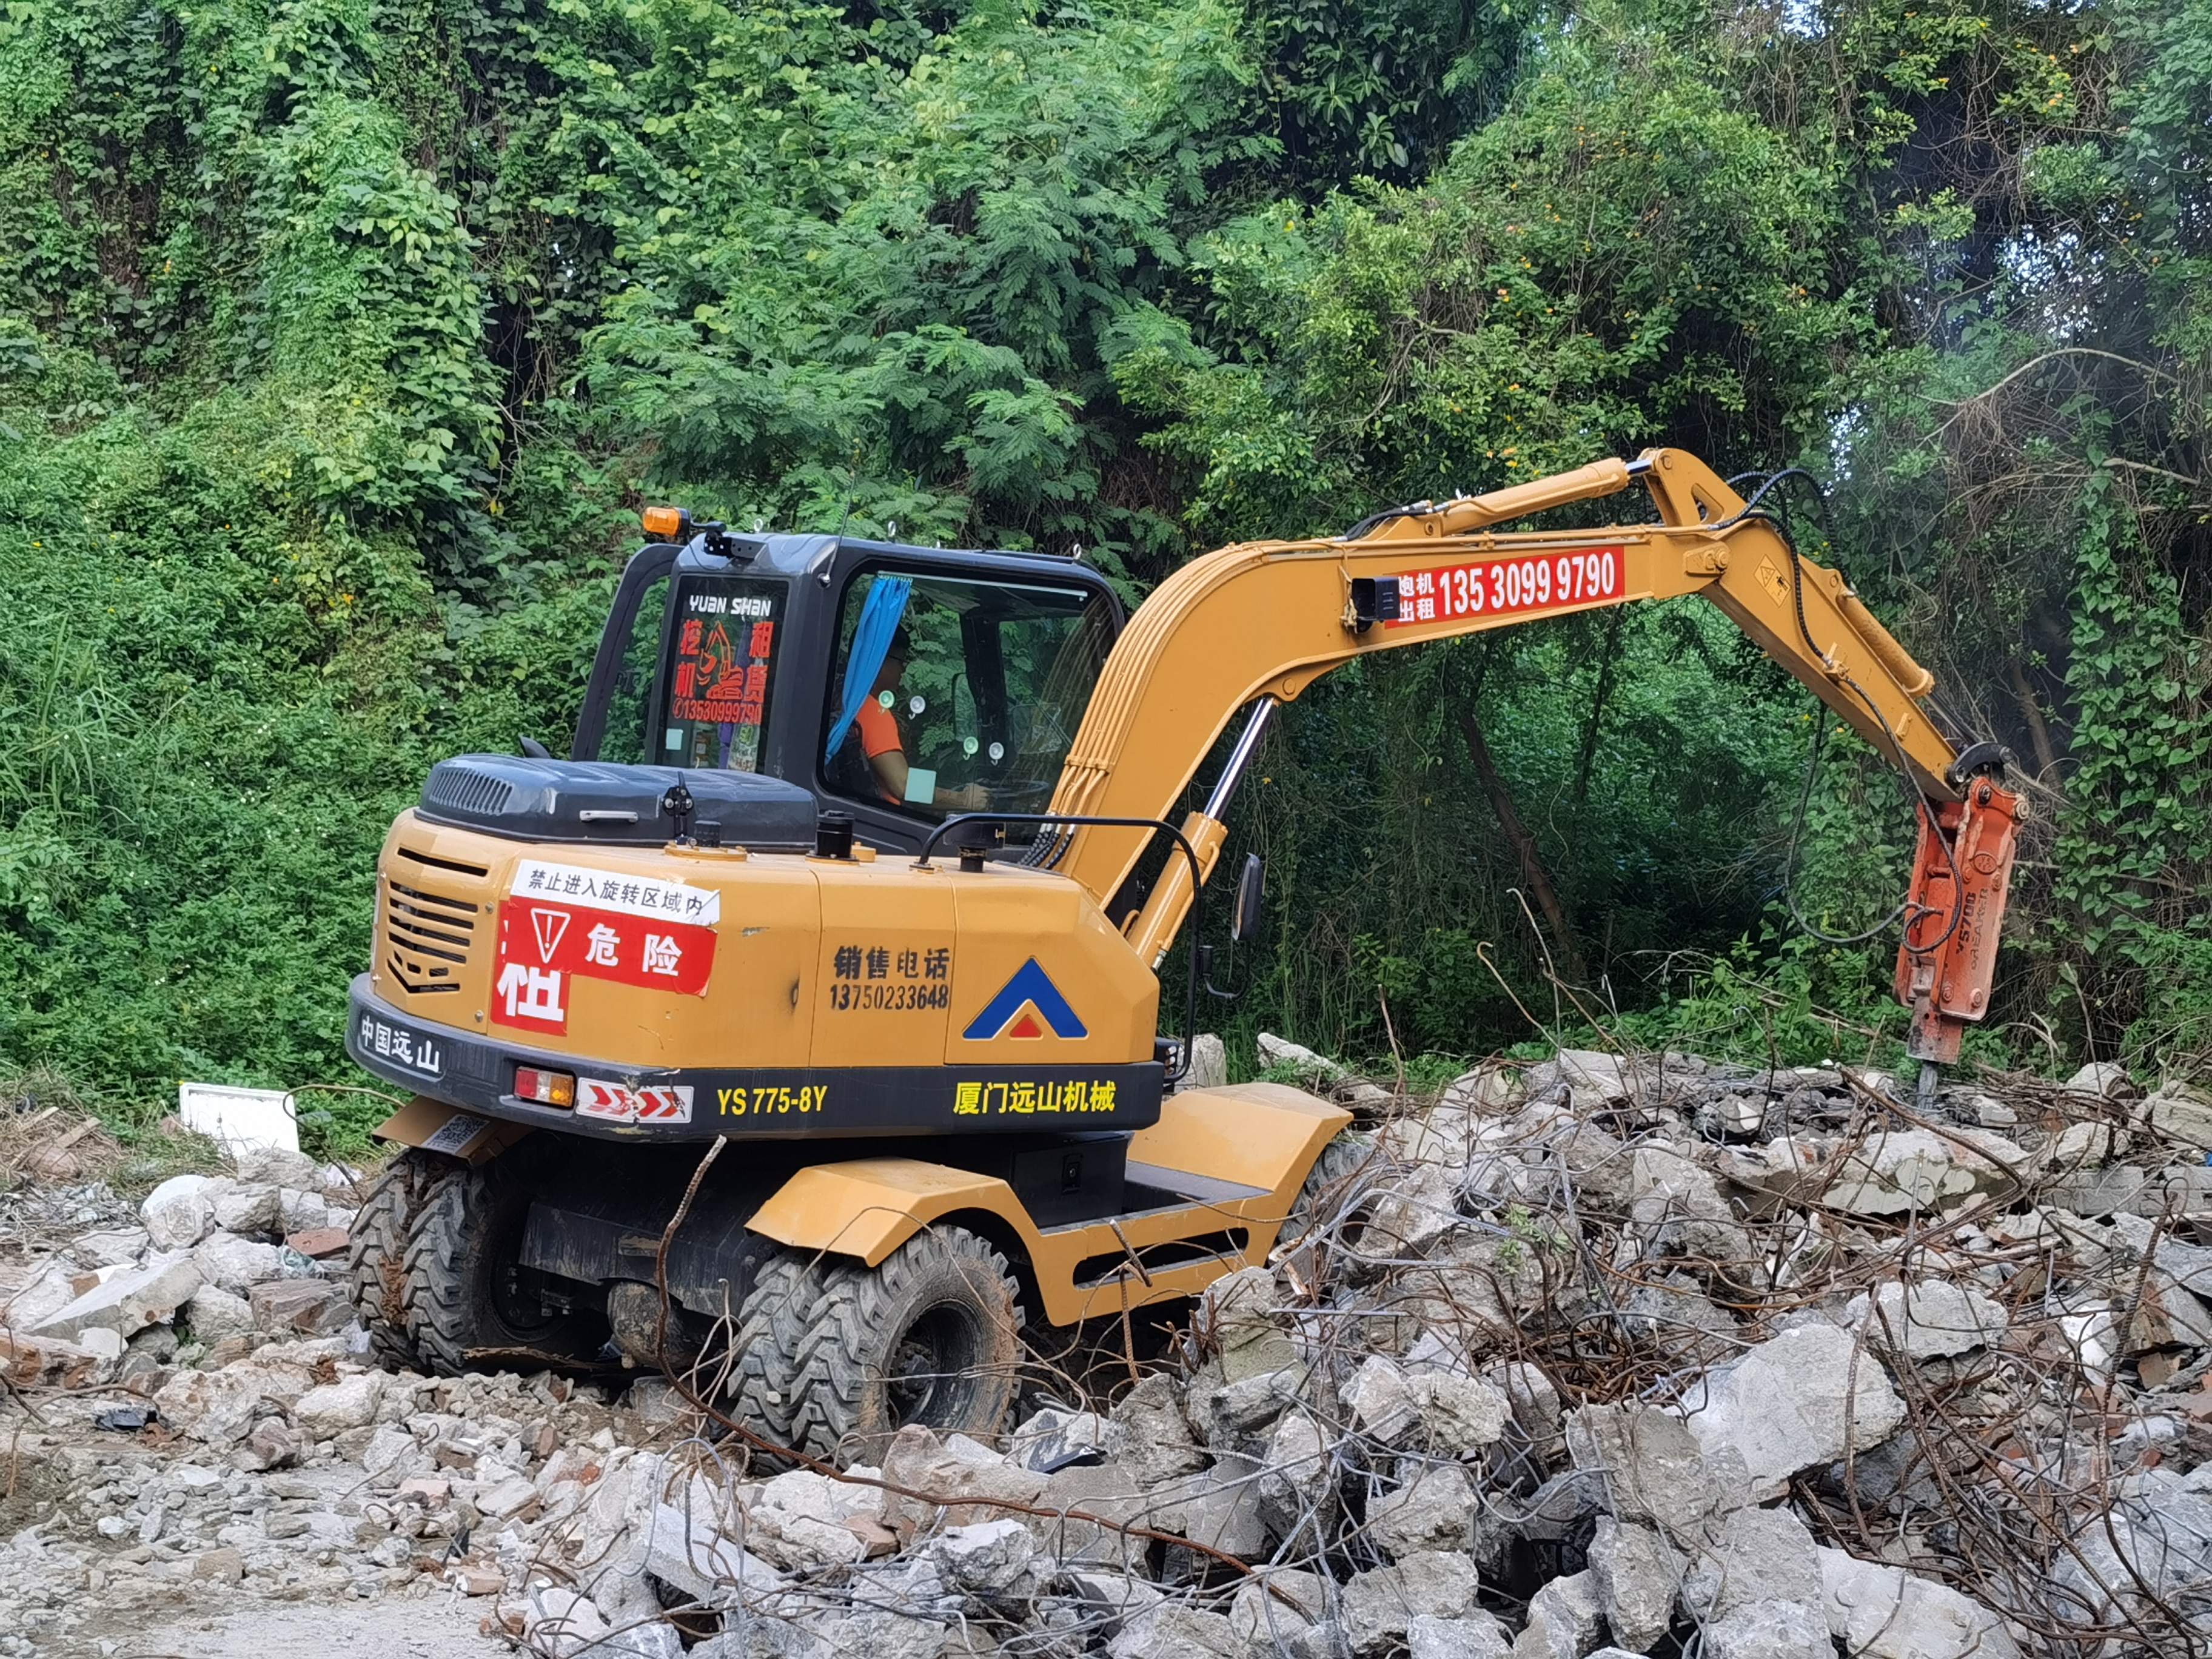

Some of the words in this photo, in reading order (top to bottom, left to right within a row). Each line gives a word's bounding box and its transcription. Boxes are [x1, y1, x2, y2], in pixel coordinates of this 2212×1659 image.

[1439, 568, 1484, 615] 135
[1490, 560, 1550, 609] 3099
[1557, 552, 1615, 600] 9790
[1398, 597, 1435, 623] 出租
[528, 868, 703, 916] 禁止进入旋转区域内
[585, 923, 682, 976] 危险
[834, 945, 950, 980] 销售电话
[830, 984, 949, 1010] 13750233648
[362, 1015, 440, 1073] 中国远山
[717, 1088, 746, 1115] YS
[752, 1085, 828, 1114] 775-8Y
[953, 1080, 1116, 1115] 厦门远山机械
